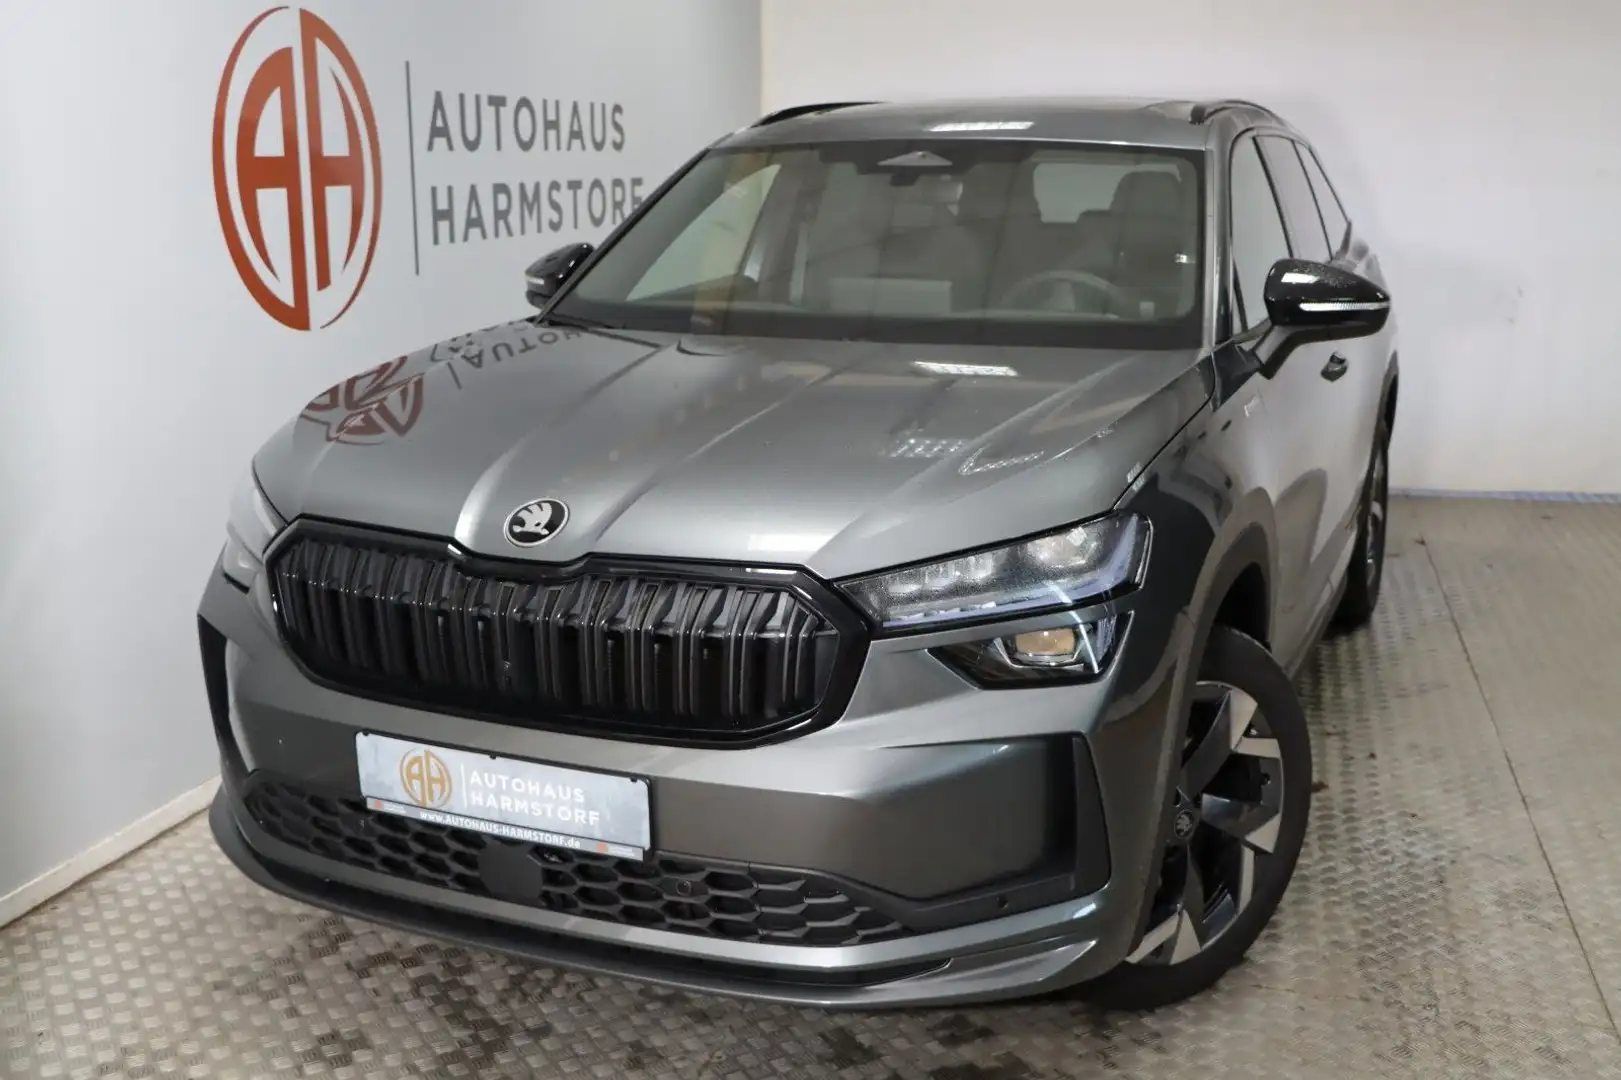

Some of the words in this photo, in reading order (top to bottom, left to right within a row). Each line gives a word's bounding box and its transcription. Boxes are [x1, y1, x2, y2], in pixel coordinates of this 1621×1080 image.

[427, 90, 626, 153] AUTOHAUS
[469, 770, 585, 803] AUTOHAUS
[470, 790, 600, 827] HARMSTORF
[419, 810, 581, 850] www.AUTOHAUS-HARMSTORF.de
